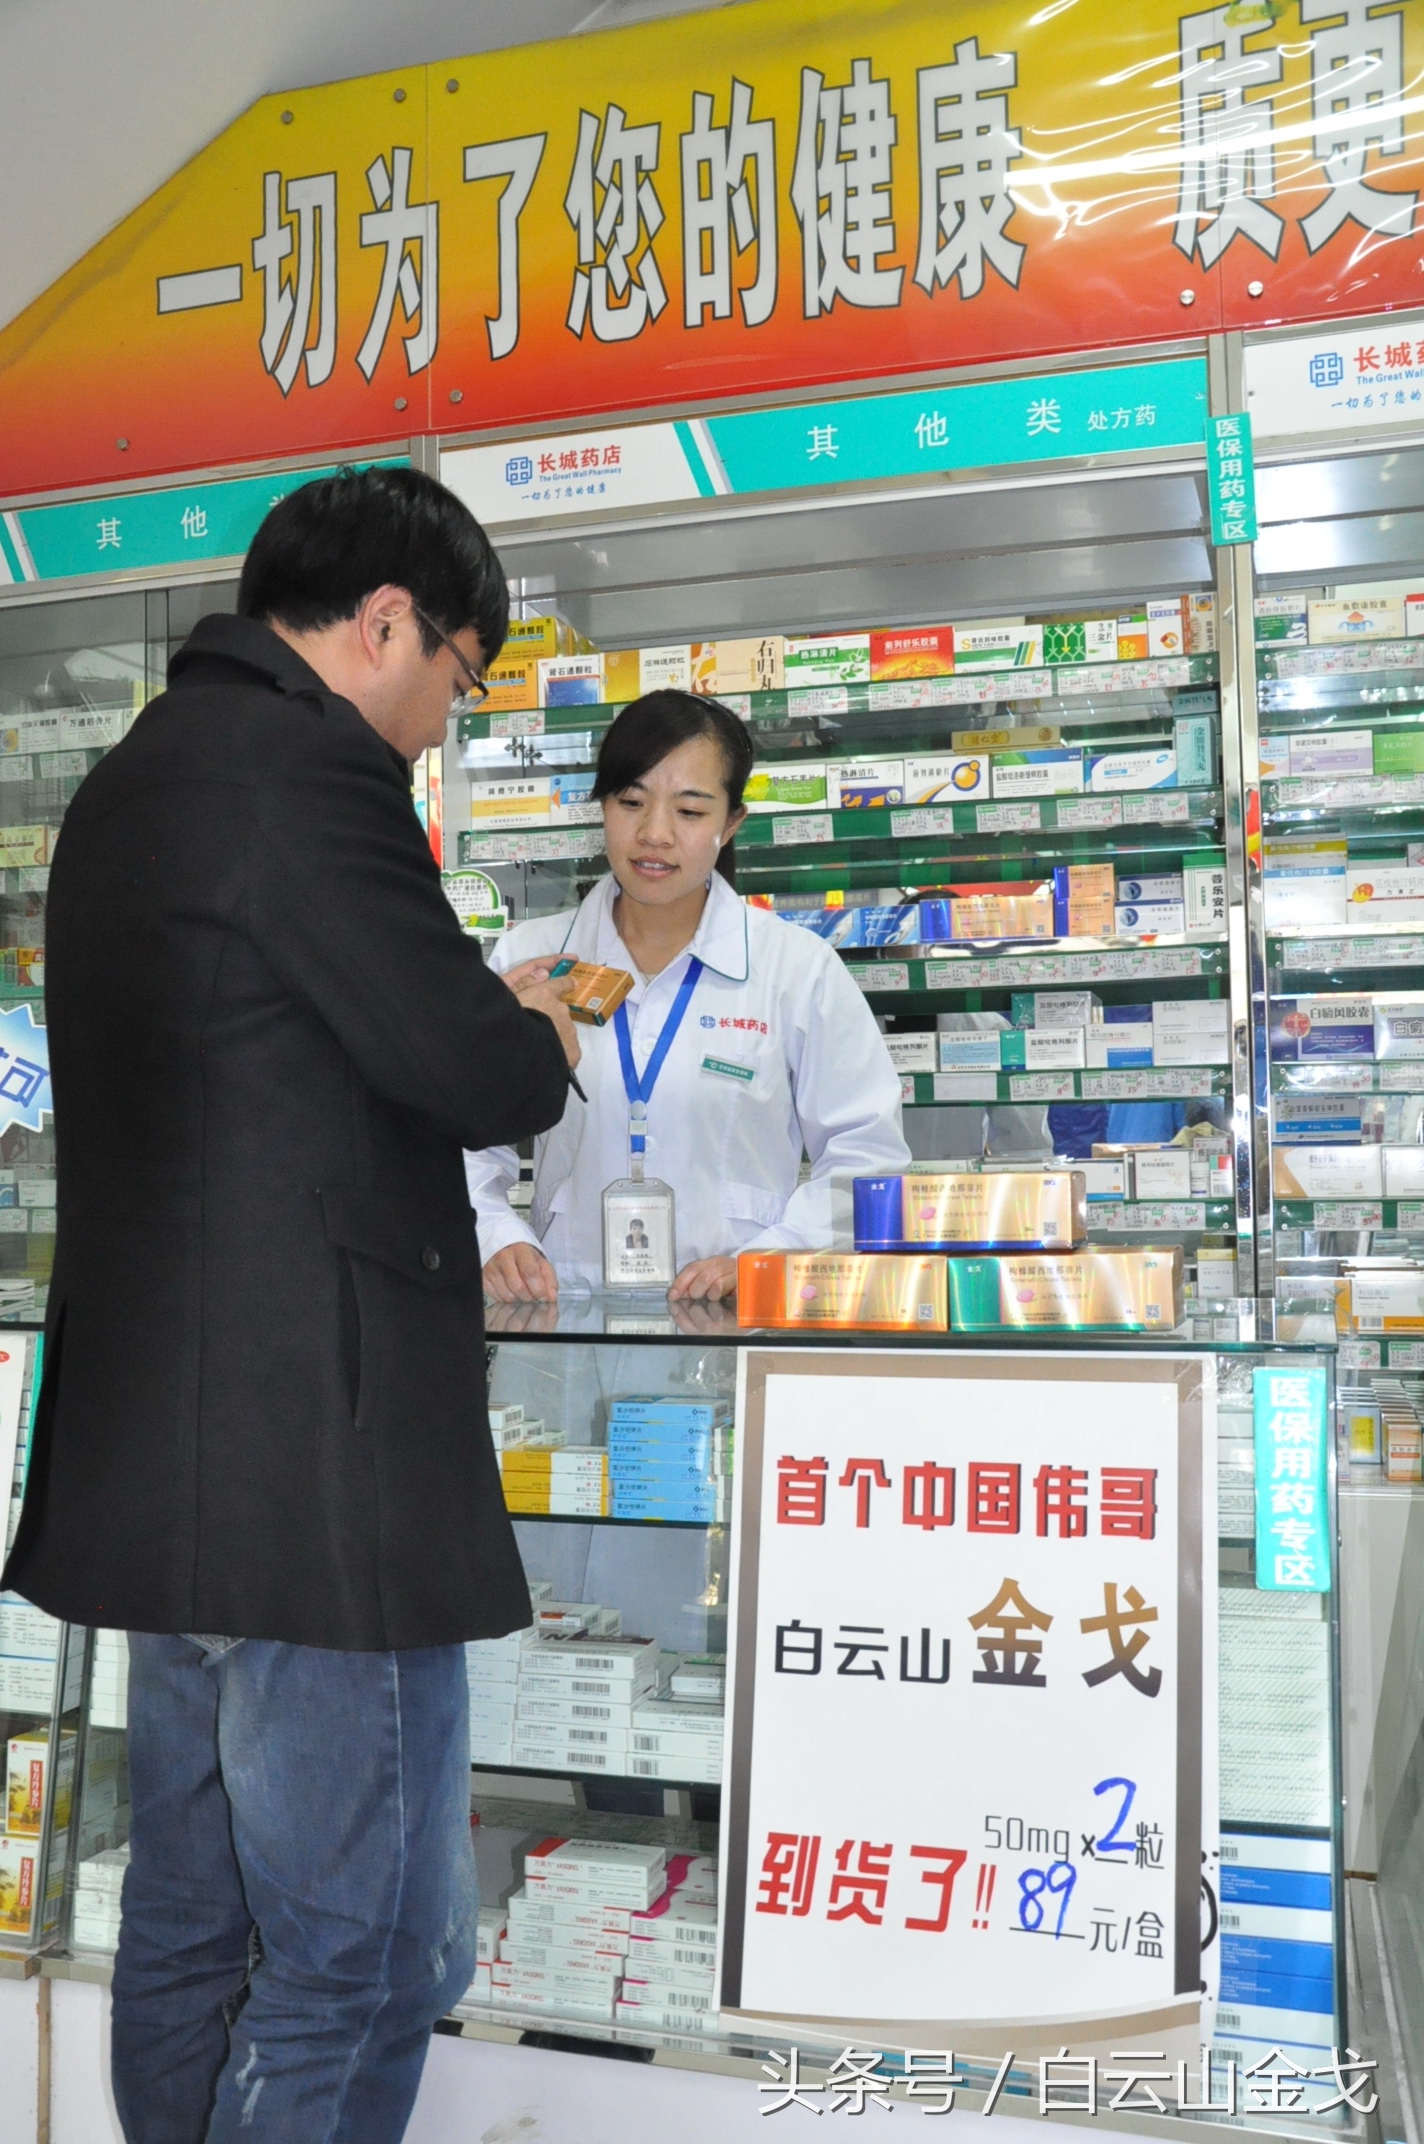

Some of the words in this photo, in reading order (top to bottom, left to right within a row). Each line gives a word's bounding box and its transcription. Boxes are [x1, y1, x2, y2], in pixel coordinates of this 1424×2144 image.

[156, 36, 1028, 399] 一切为了您的健康
[1356, 376, 1374, 385] The
[1375, 372, 1402, 383] Great
[1088, 403, 1157, 432] 处方药
[537, 445, 621, 473] 长城药店
[538, 475, 552, 483] The
[552, 471, 572, 481] Great
[572, 469, 588, 479] Wall
[588, 467, 622, 477] Pharmacy
[1215, 417, 1248, 540] 医保用药专区
[521, 482, 607, 501] 一切为了您的健康
[757, 640, 776, 689] 右归丸
[1211, 874, 1224, 919] 普乐安片
[719, 1018, 767, 1035] 长城药店
[776, 1455, 1158, 1540] 首个中国伟哥
[1269, 1376, 1317, 1587] 医保用药专区
[774, 1619, 951, 1684] 白云山
[967, 1576, 1163, 1698] 金戈
[984, 1815, 1070, 1863] 50mg
[755, 1831, 997, 1932] 到货了!!
[1017, 1860, 1078, 1940] 89
[1089, 1907, 1165, 1959] 元/盒
